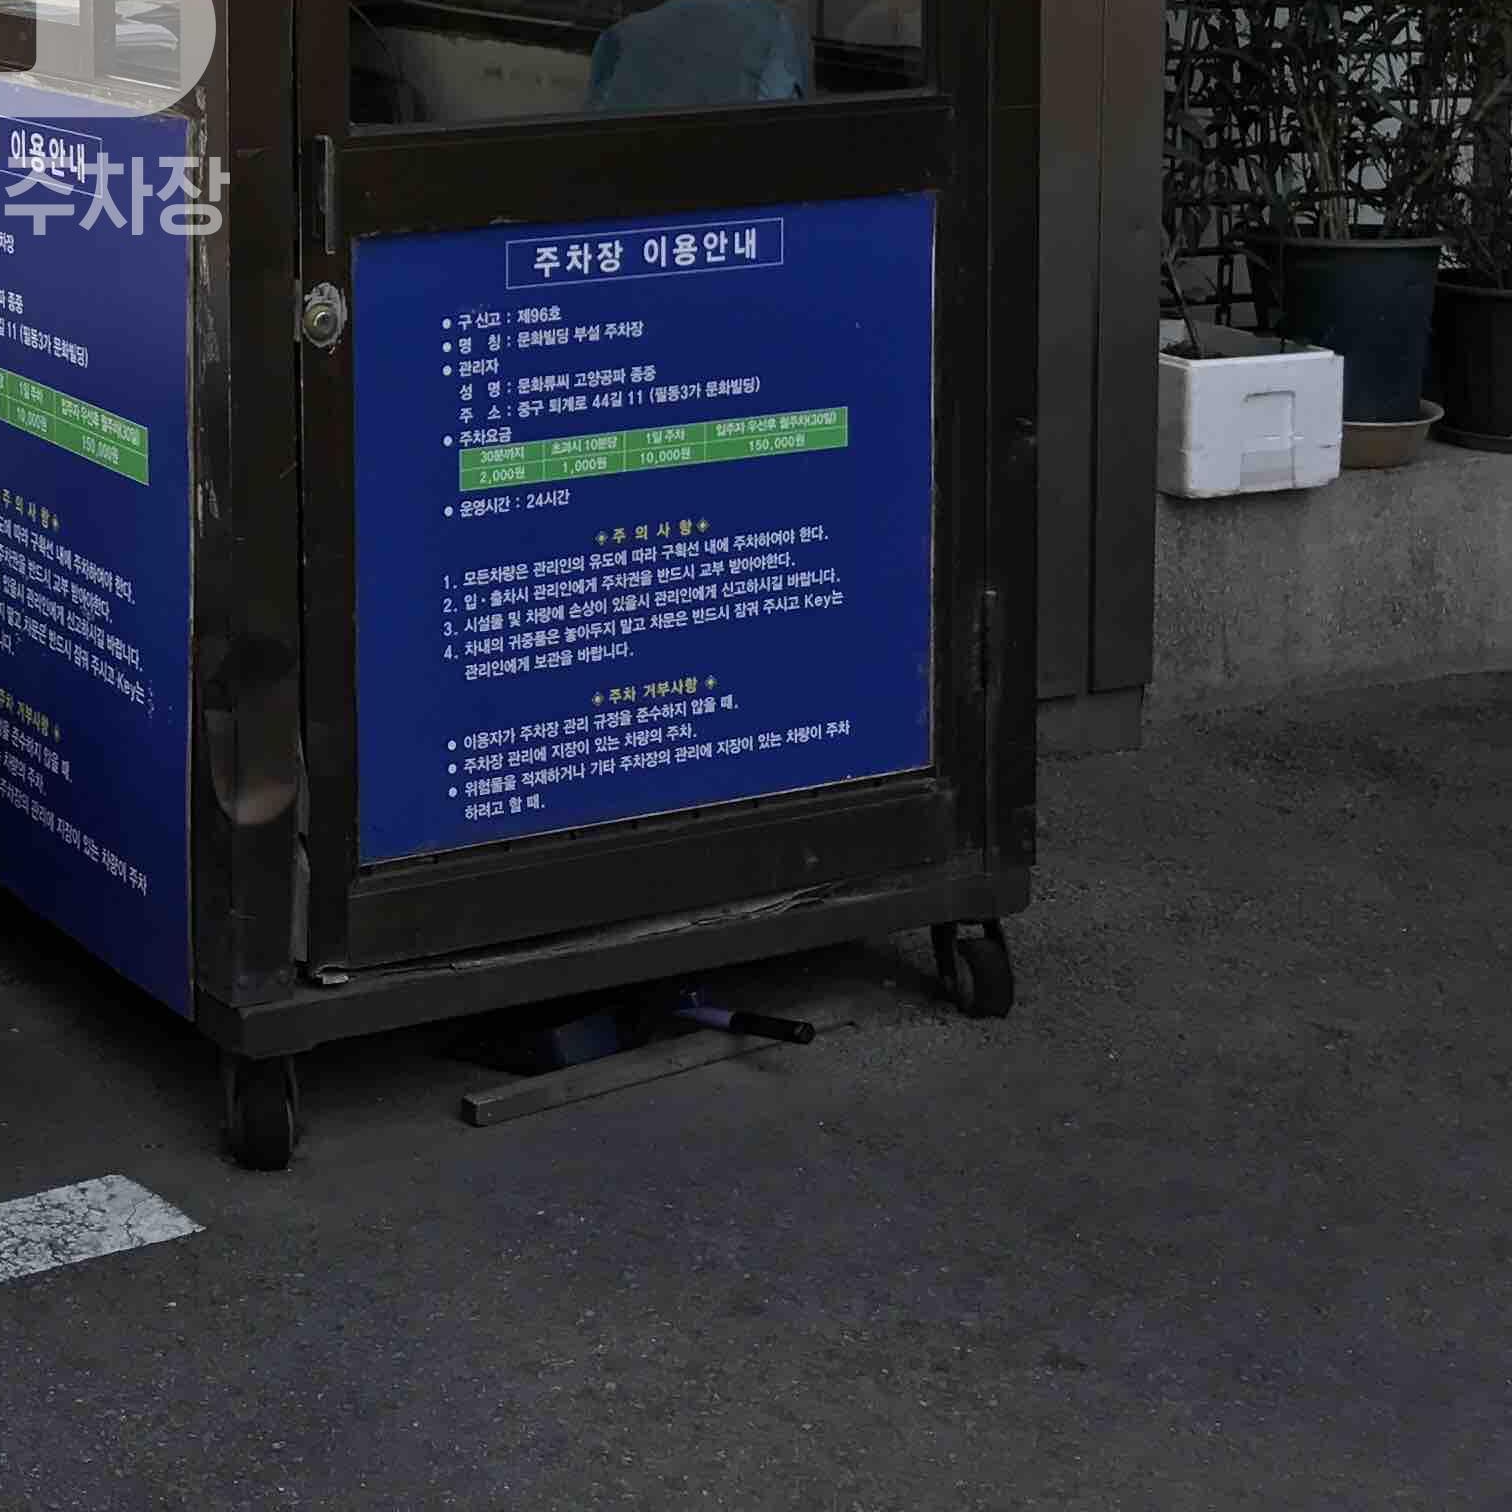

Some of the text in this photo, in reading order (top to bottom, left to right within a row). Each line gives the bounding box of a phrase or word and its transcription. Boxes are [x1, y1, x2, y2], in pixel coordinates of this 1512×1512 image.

[10, 130, 87, 182] 이용안내
[534, 228, 756, 277] 주차장 이용안내
[517, 305, 561, 323] 제96호
[517, 320, 643, 348] 문화빌딩 부설 주차장
[458, 357, 499, 377] 관리자
[517, 399, 544, 417] 중구
[591, 390, 622, 408] 44길
[627, 389, 642, 405] 11
[649, 382, 701, 403] (필동3가
[705, 376, 760, 397] 문화빌딩)
[459, 426, 511, 446] 주차요금
[643, 427, 685, 445] 1일 주차
[747, 434, 806, 453] 150,000원
[561, 456, 608, 475] 1,000원
[638, 446, 691, 465] 10,000원
[479, 463, 525, 484] 2,000원
[459, 488, 570, 517] 운영시간 24시간
[463, 563, 528, 585] 모든차량은
[532, 555, 584, 577] 관리인의
[589, 549, 627, 569] 유도에
[631, 545, 657, 563] 따라
[703, 536, 729, 554] 내에
[733, 529, 795, 550] 주차하여야
[798, 524, 828, 542] 한다.
[533, 577, 597, 600] 관리인에게
[601, 569, 652, 590] 주차권을
[656, 563, 694, 583] 반드시
[699, 560, 724, 576] 교부
[728, 551, 795, 574] 받아야한다.
[464, 613, 503, 632] 시설물
[507, 609, 520, 627] 및
[525, 604, 564, 624] 차량에
[568, 598, 607, 618] 손상이
[611, 592, 649, 612] 있을시
[654, 583, 717, 606] 관리인에게
[721, 574, 782, 597] 신고하시길
[786, 567, 840, 587] 바랍니다.
[464, 636, 503, 656] 차내의
[508, 628, 559, 649] 귀중품은
[564, 620, 615, 642] 놓아두지
[619, 617, 646, 634] 말고
[649, 610, 688, 629] 차문은
[691, 604, 729, 624] 반드시
[762, 595, 800, 614] 주시고
[804, 589, 843, 608] Key는
[465, 641, 633, 680] 관리인에게 보관을 바랍니다.
[608, 676, 697, 704] 주차 거부사항
[463, 693, 738, 749] 이용자가 주차장 관리 규정을 준수하지 않을 때.
[463, 722, 696, 773] 주차장 관리에 지장이 있는 차량의 주차.
[464, 774, 515, 796] 위험물을
[590, 757, 616, 775] 기타
[619, 749, 670, 771] 주차장의
[674, 742, 712, 762] 관리에
[716, 735, 753, 754] 지장이
[757, 731, 782, 749] 있는
[785, 723, 821, 743] 차량이
[825, 719, 850, 737] 주차
[464, 793, 545, 820] 하려고 할 때.
